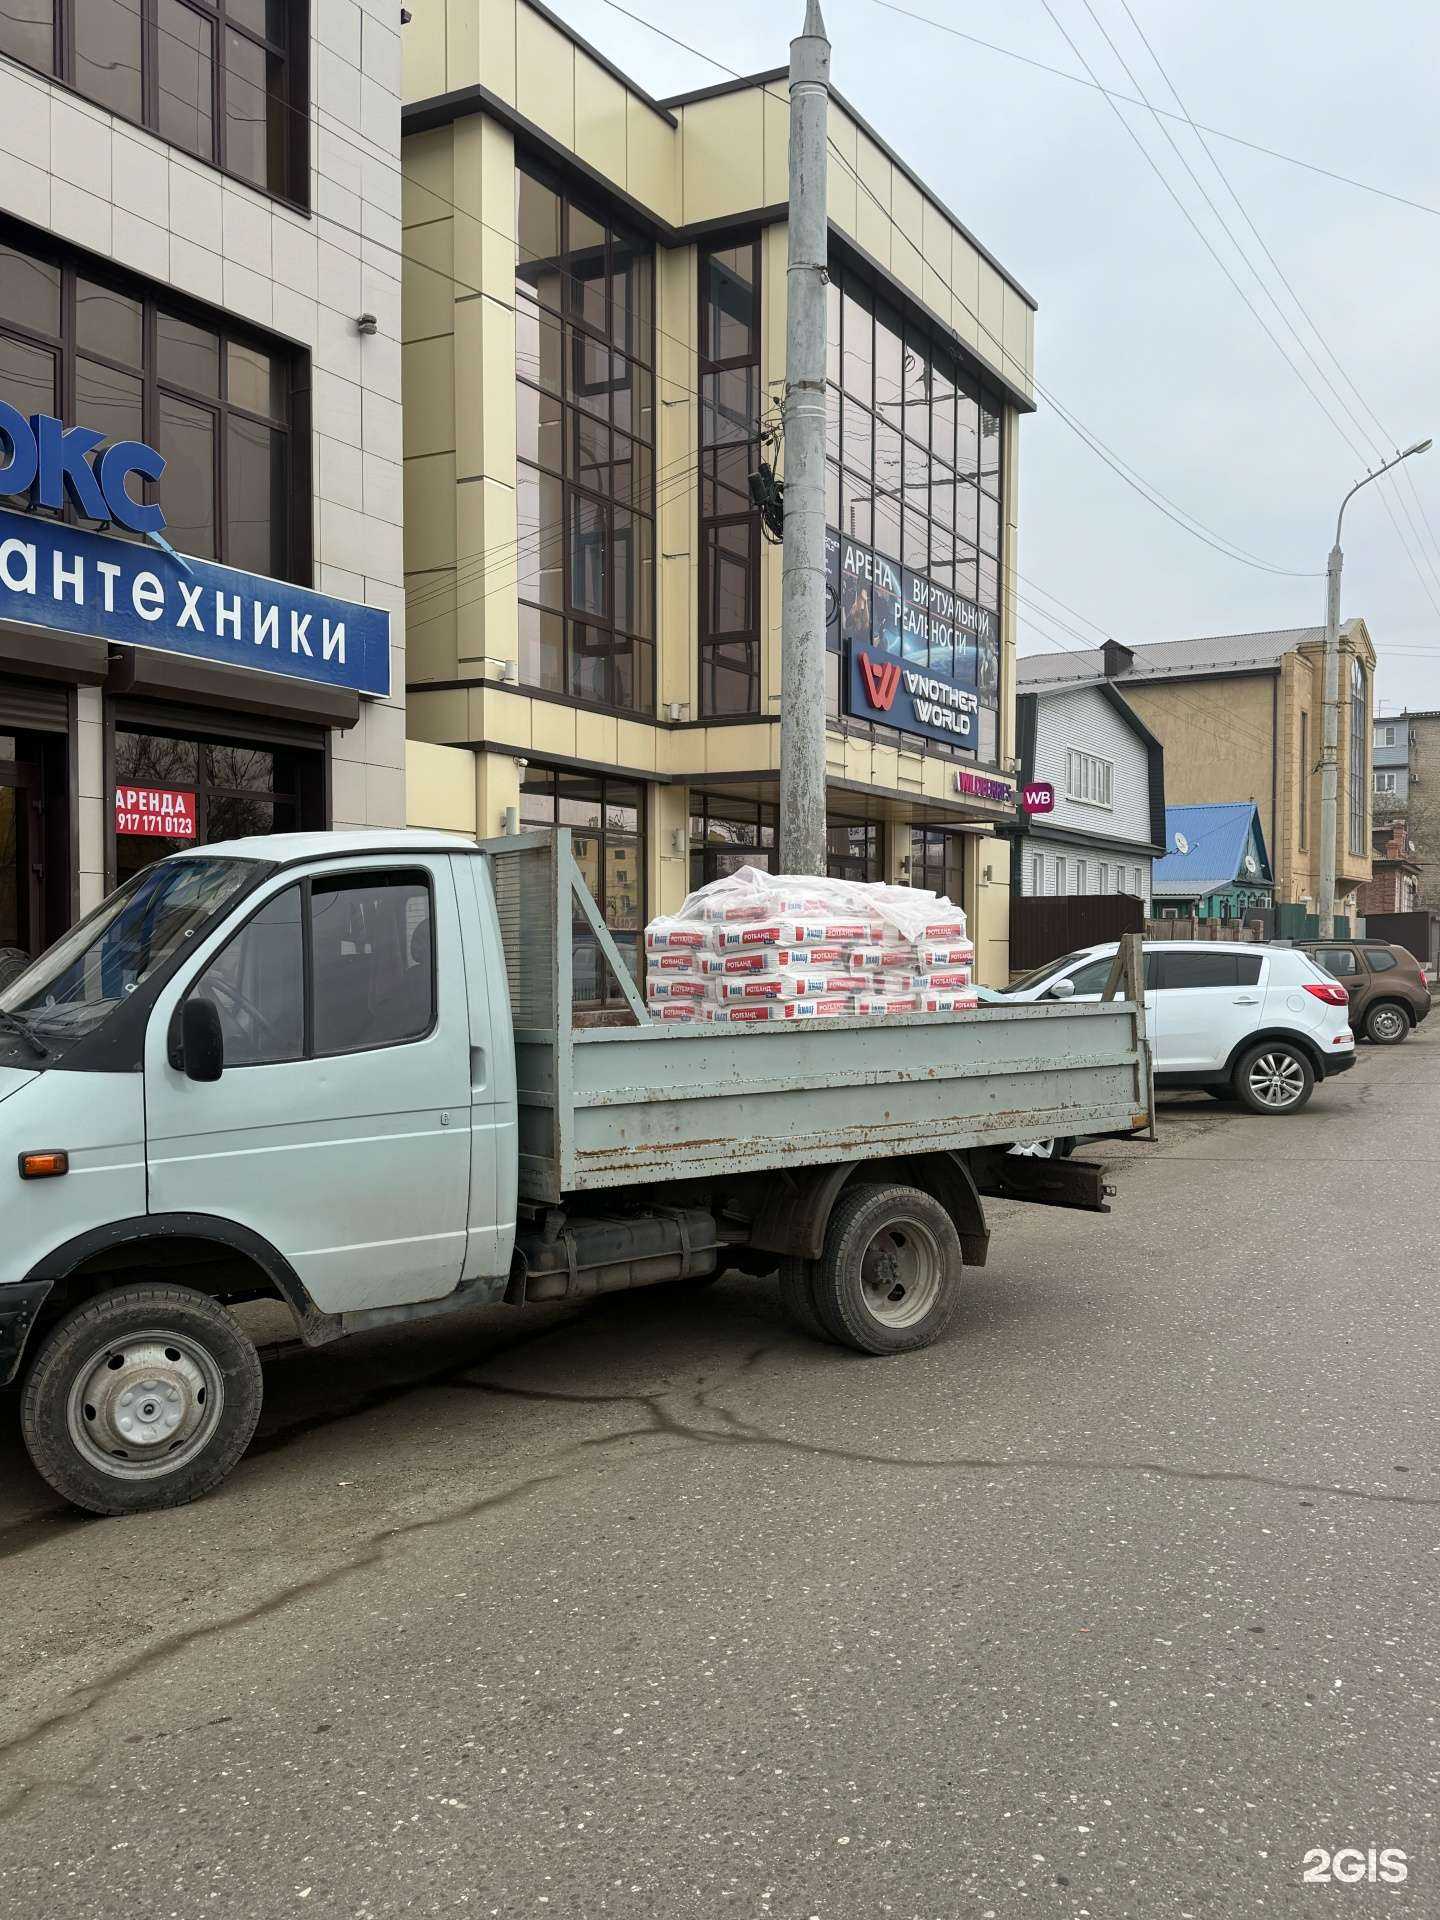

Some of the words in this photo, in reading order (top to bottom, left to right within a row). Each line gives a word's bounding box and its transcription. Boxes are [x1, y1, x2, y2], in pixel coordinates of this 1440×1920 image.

[844, 545, 893, 590] АРЕНА
[0, 539, 346, 664] антехники
[913, 579, 989, 636] ВИРТУАЛЬНОЙ
[894, 603, 967, 656] РЕАЛЬНОСТИ
[913, 698, 971, 736] WORLD
[116, 789, 186, 817] АРЕНДА
[1026, 791, 1051, 805] WB
[118, 813, 140, 831] 917
[142, 815, 162, 832] 171
[165, 817, 192, 834] 0123
